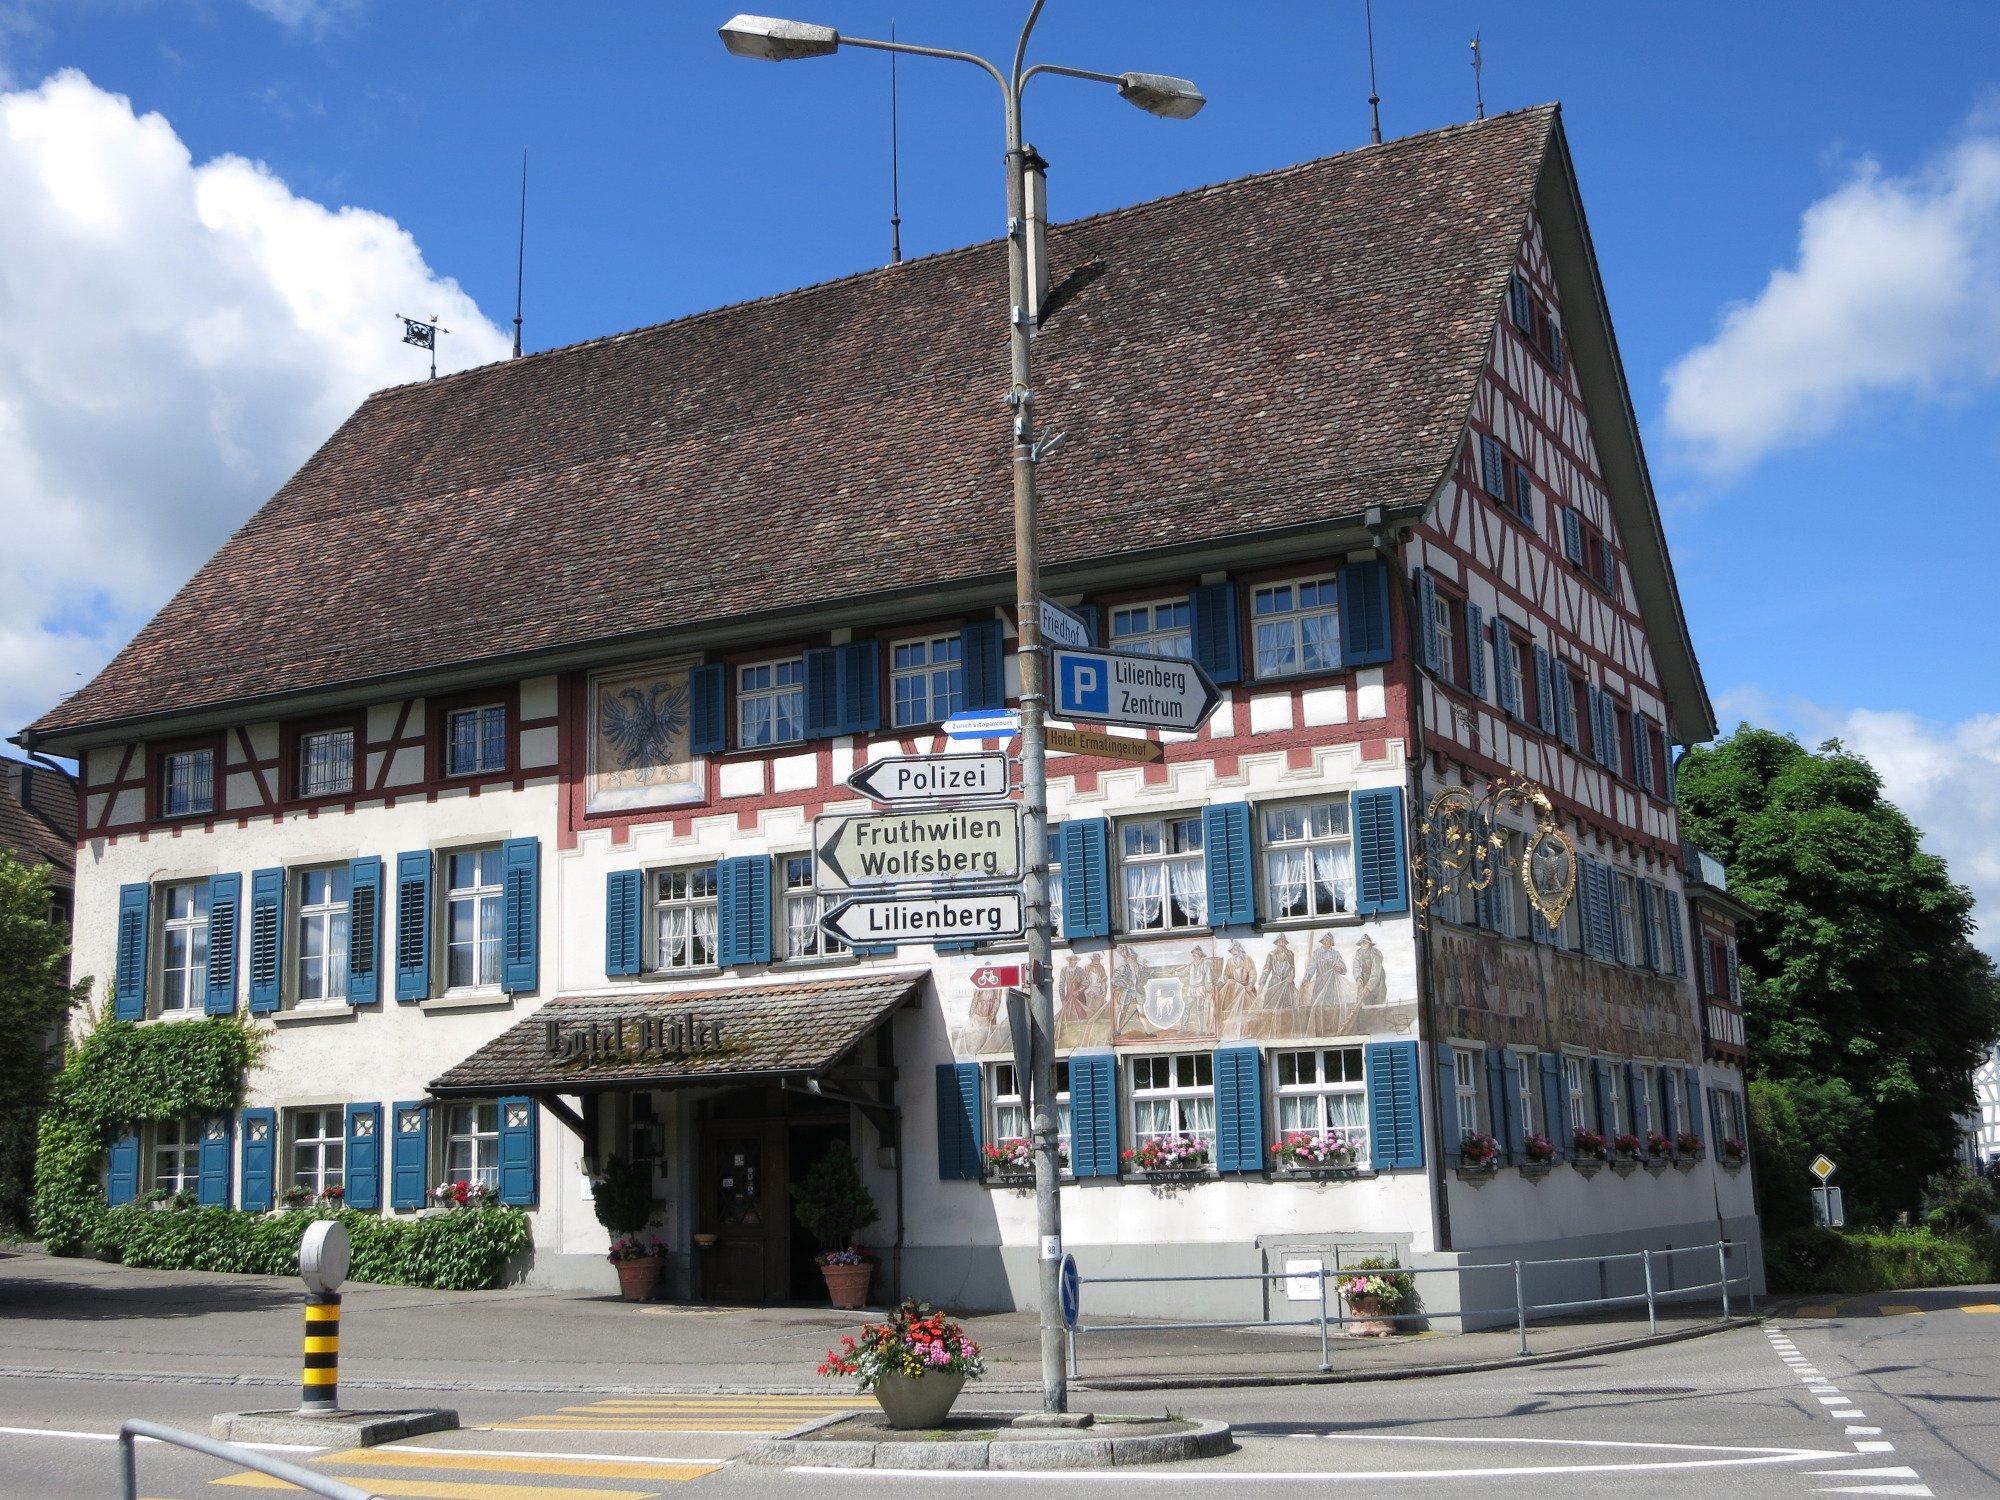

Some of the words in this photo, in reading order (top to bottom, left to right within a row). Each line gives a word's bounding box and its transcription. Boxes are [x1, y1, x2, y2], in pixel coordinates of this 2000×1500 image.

[1043, 609, 1080, 645] Friedhof
[1073, 665, 1097, 705] P
[1115, 661, 1186, 695] Lilienberg
[1121, 691, 1183, 718] Zentrum
[1051, 731, 1076, 748] Hotel
[1080, 734, 1147, 757] Ermatingerhof
[898, 764, 986, 791] Polizei
[856, 816, 1001, 846] Fruthwilen
[860, 849, 998, 876] Wolfsberg
[869, 904, 1002, 932] Lilienberg
[545, 1016, 623, 1057] Hotel
[635, 1013, 725, 1055] Adler
[1047, 1245, 1056, 1255] 98
